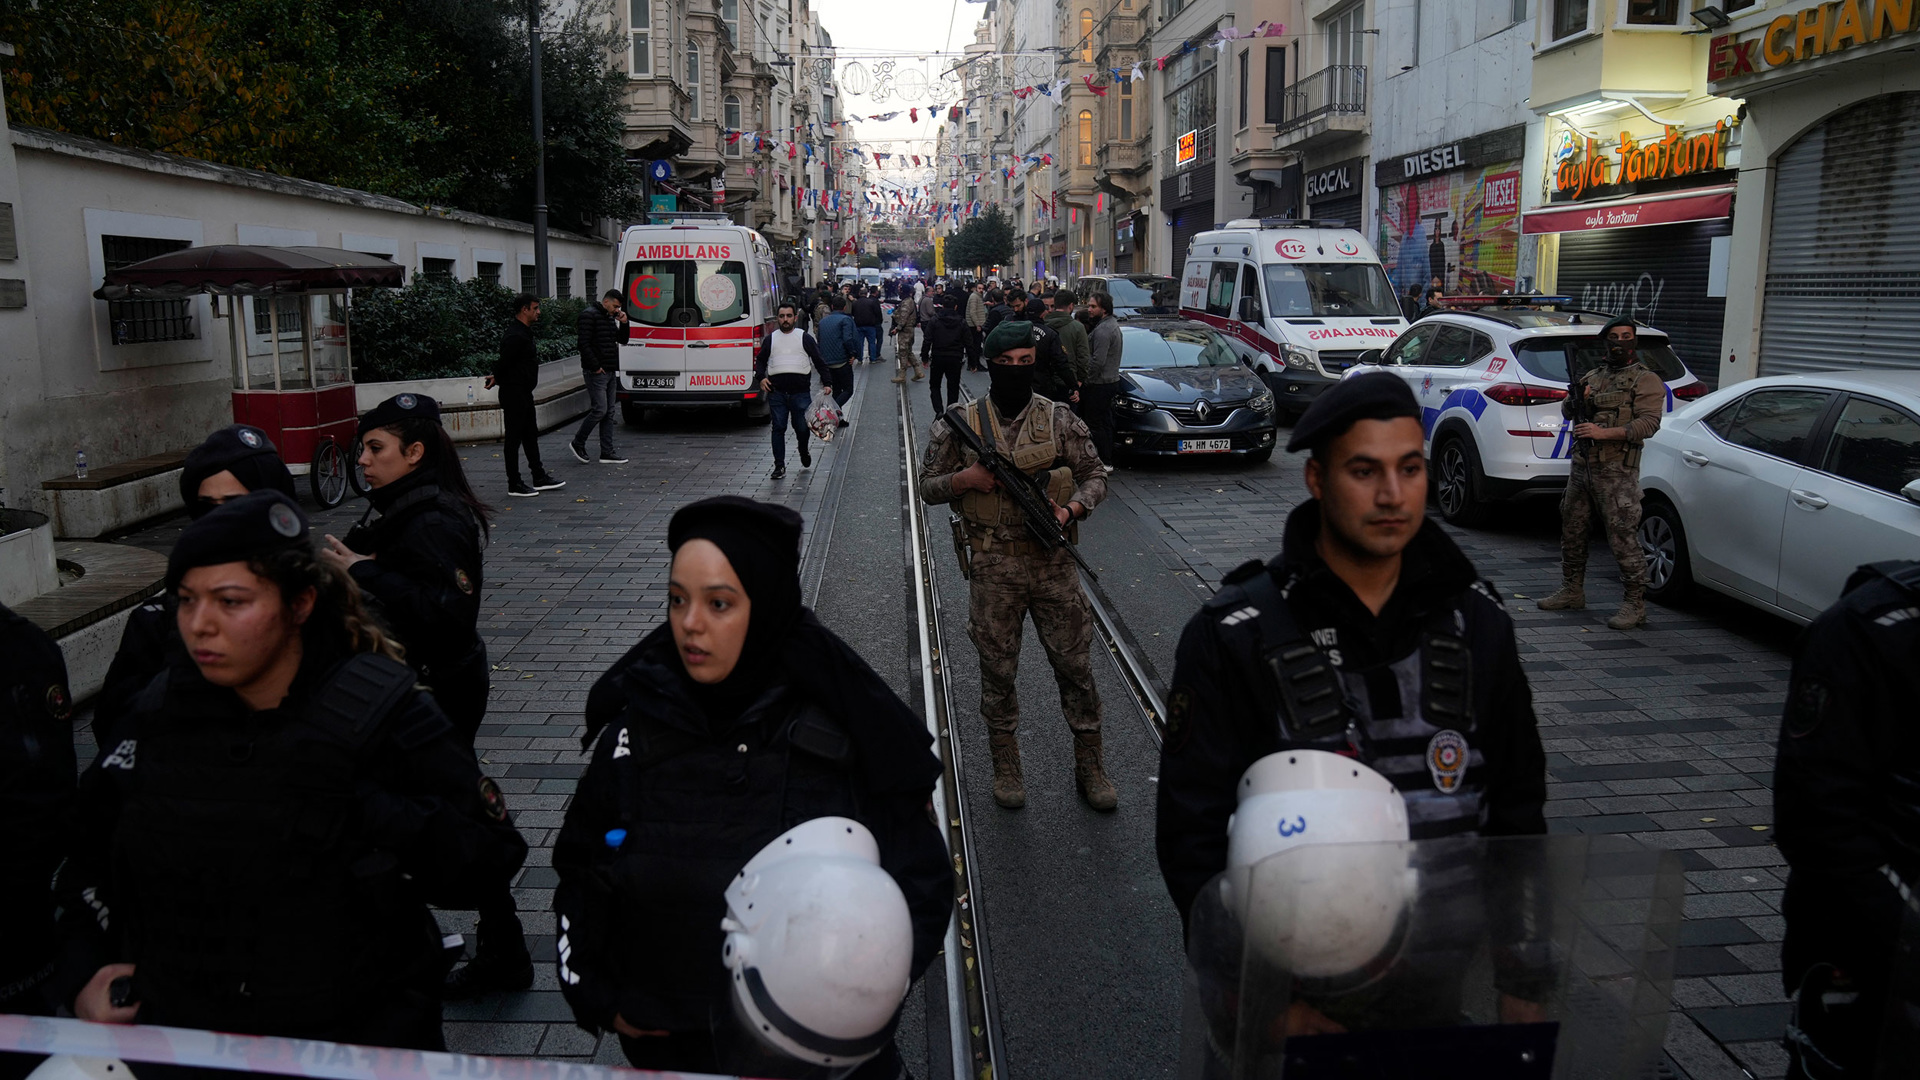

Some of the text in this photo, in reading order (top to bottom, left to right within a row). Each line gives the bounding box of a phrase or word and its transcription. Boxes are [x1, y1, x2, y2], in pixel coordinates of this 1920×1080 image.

[1180, 132, 1194, 150] CAFE
[1404, 146, 1465, 178] DIESEL
[1557, 119, 1723, 199] ayla tantuni
[1307, 167, 1350, 197] GLOCAL
[1485, 178, 1516, 208] DIESEL
[1585, 209, 1639, 228] ayla tantuni
[636, 245, 731, 259] AMBULANS
[1283, 244, 1306, 253] 112
[643, 287, 661, 298] 112
[1490, 359, 1503, 373] 112
[636, 378, 645, 386] 34
[647, 378, 656, 386] VZ
[689, 374, 746, 386] AMBULANS
[1183, 440, 1229, 449] 34 HM 4672
[1310, 627, 1338, 648] VVET
[1278, 814, 1306, 837] 3
